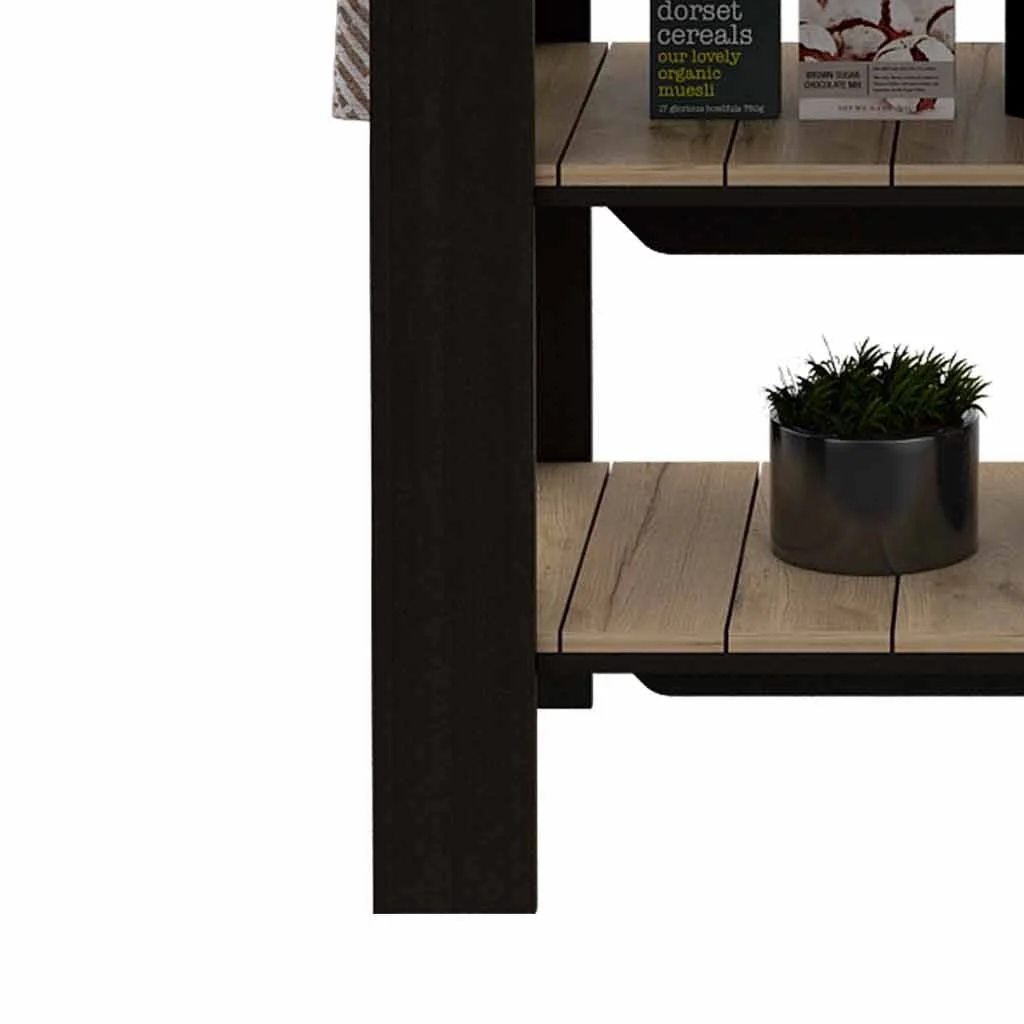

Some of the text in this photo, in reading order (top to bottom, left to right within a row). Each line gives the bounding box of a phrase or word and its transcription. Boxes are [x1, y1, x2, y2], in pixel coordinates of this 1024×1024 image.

[657, 0, 743, 21] dorset
[657, 23, 753, 45] cereals
[658, 48, 741, 66] our lovely
[658, 66, 722, 83] organic
[657, 81, 715, 97] muesli
